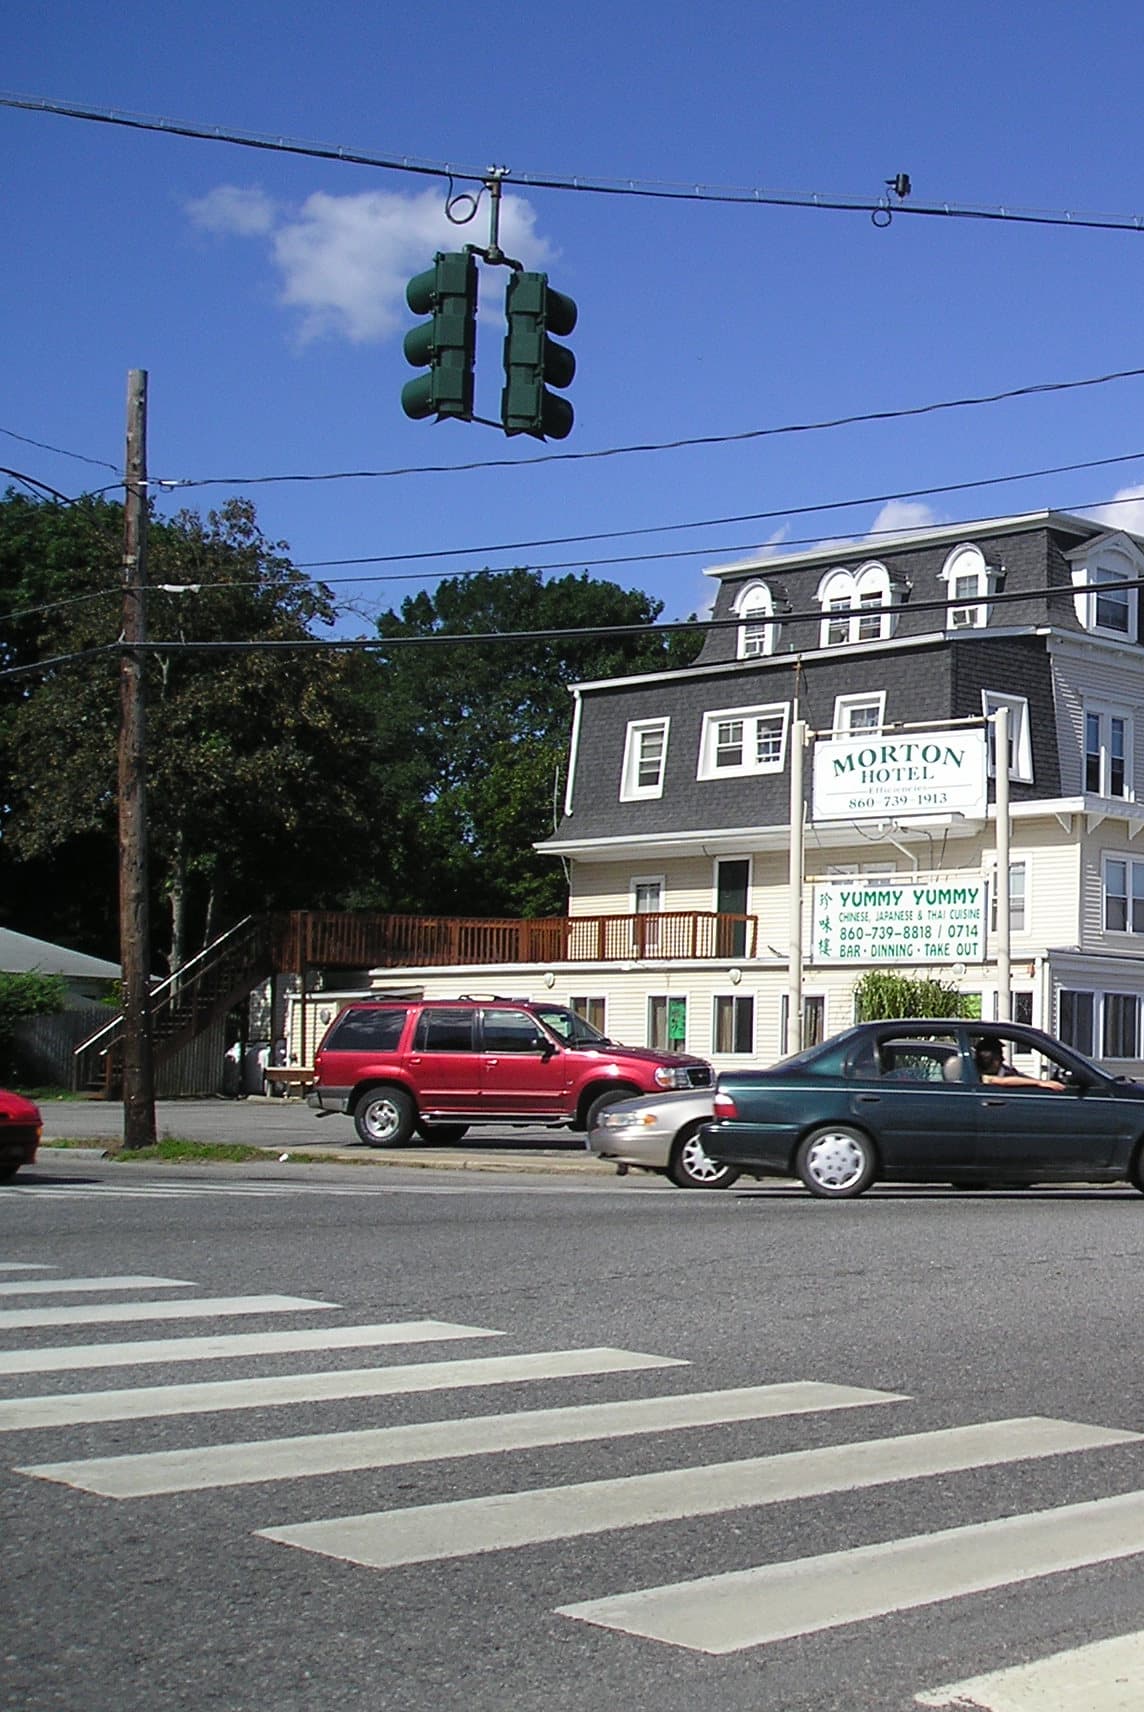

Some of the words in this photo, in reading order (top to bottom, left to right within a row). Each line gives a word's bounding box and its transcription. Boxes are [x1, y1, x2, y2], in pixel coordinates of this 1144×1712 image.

[832, 744, 965, 777] MORTON
[862, 766, 935, 783] HOTEL
[840, 890, 903, 907] YUMMY
[913, 888, 979, 905] YUMMY
[839, 912, 871, 923] CHINESE,
[875, 910, 913, 922] JAPANESE
[918, 910, 922, 920] &
[927, 909, 946, 920] THAI
[950, 908, 981, 919] CUISINE
[840, 925, 932, 940] 860-739-8818
[948, 925, 978, 938] 0714
[840, 944, 861, 957] BAR
[871, 944, 913, 957] DINNING
[925, 943, 949, 956] TAKE
[956, 943, 978, 955] OUT
